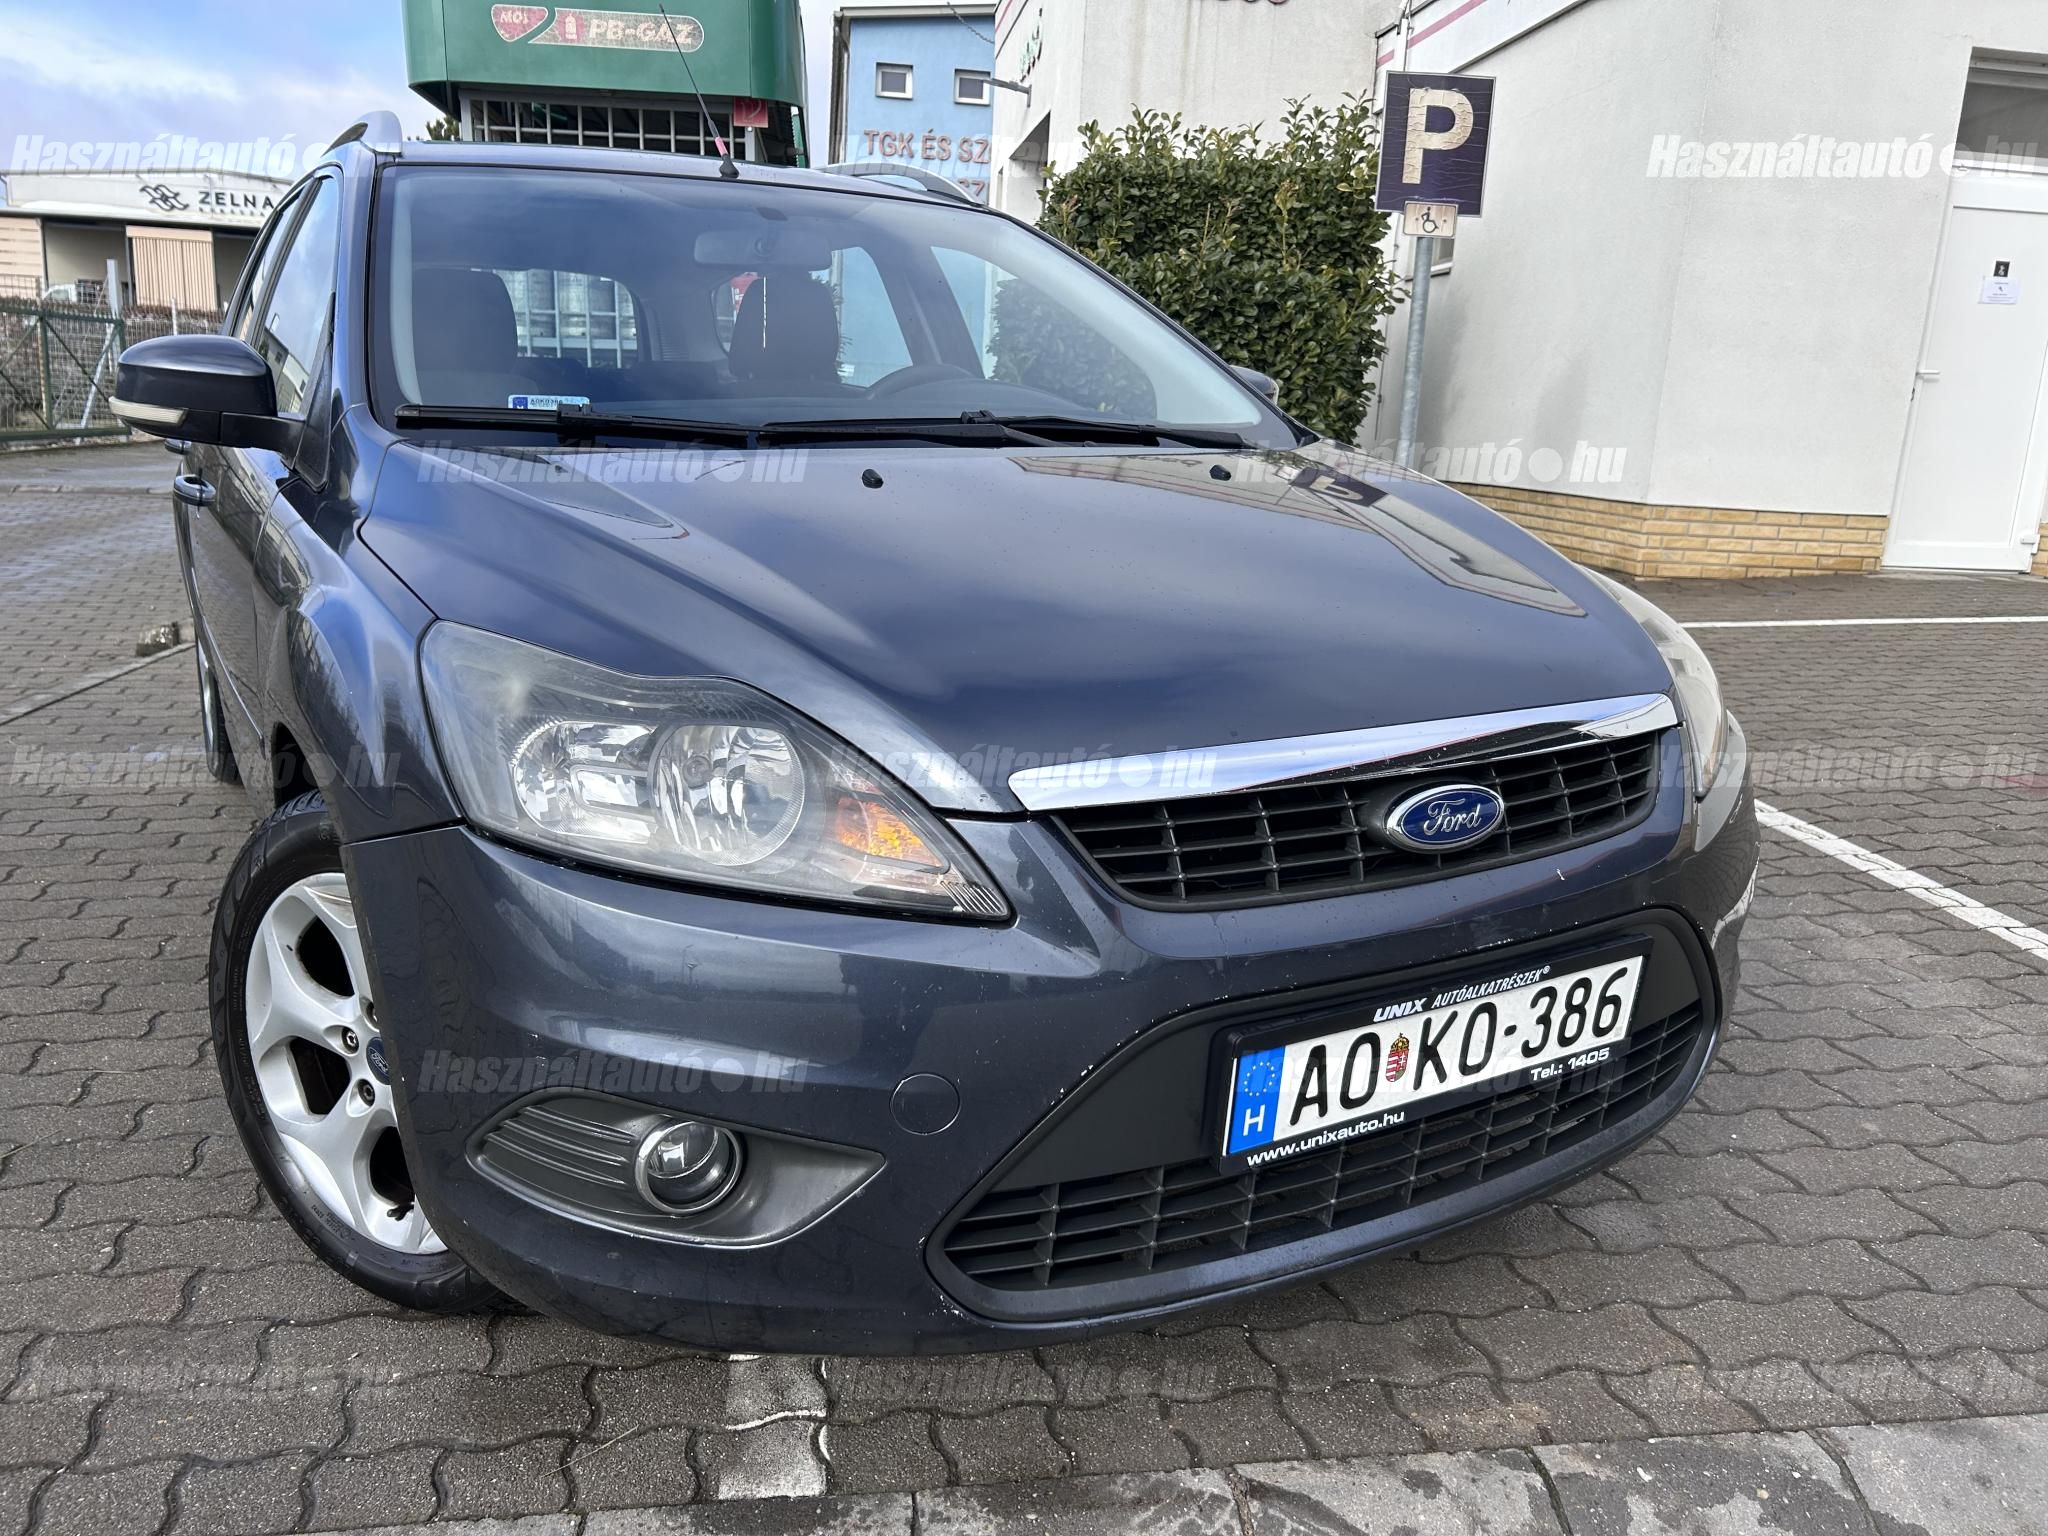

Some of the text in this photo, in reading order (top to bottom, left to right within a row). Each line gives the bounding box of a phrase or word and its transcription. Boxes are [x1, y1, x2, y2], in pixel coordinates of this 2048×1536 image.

[864, 129, 914, 158] TGK
[921, 128, 951, 161] ÉS
[1402, 87, 1474, 185] P
[1424, 798, 1482, 835] Ford
[1373, 998, 1427, 1022] UNIX
[1531, 1047, 1610, 1080] Tel.: 1405
[1243, 1104, 1265, 1136] H
[1247, 1111, 1404, 1166] www.unixauto.hu
